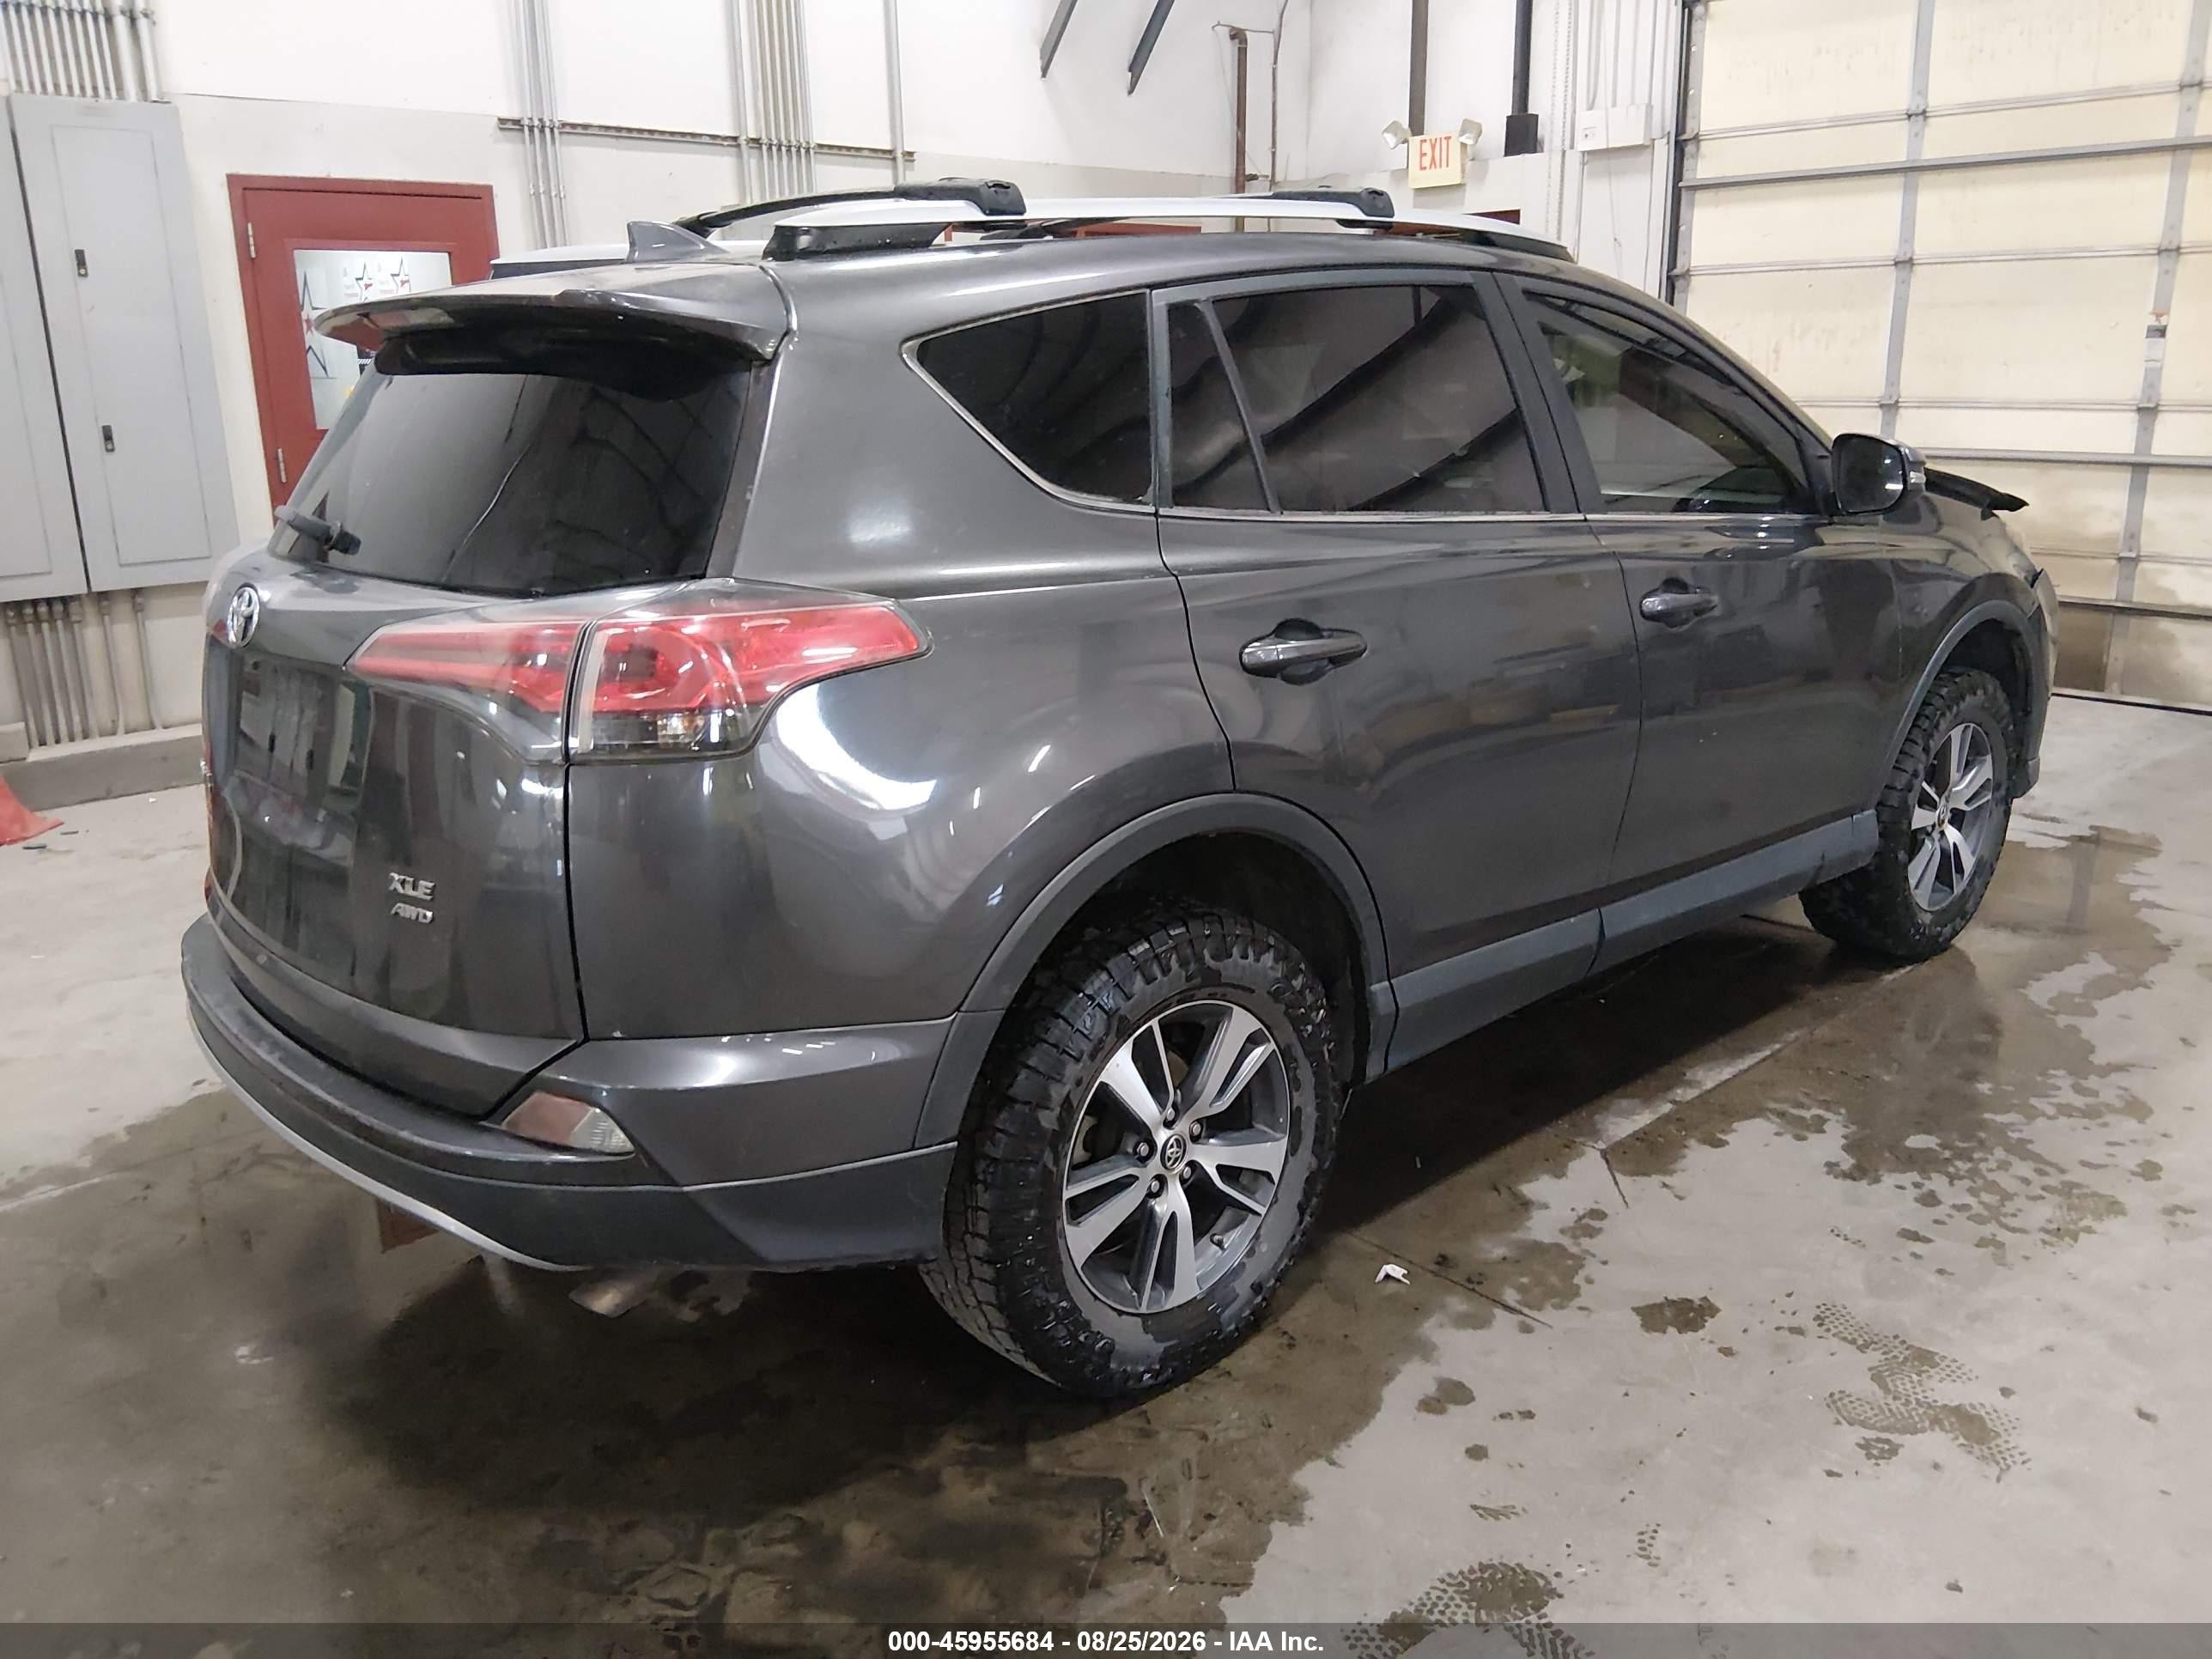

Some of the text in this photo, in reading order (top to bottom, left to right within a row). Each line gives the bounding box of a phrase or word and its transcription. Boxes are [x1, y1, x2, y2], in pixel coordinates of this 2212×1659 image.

[1419, 136, 1451, 171] EXIT
[389, 872, 434, 901] XLE
[391, 902, 434, 924] AWD
